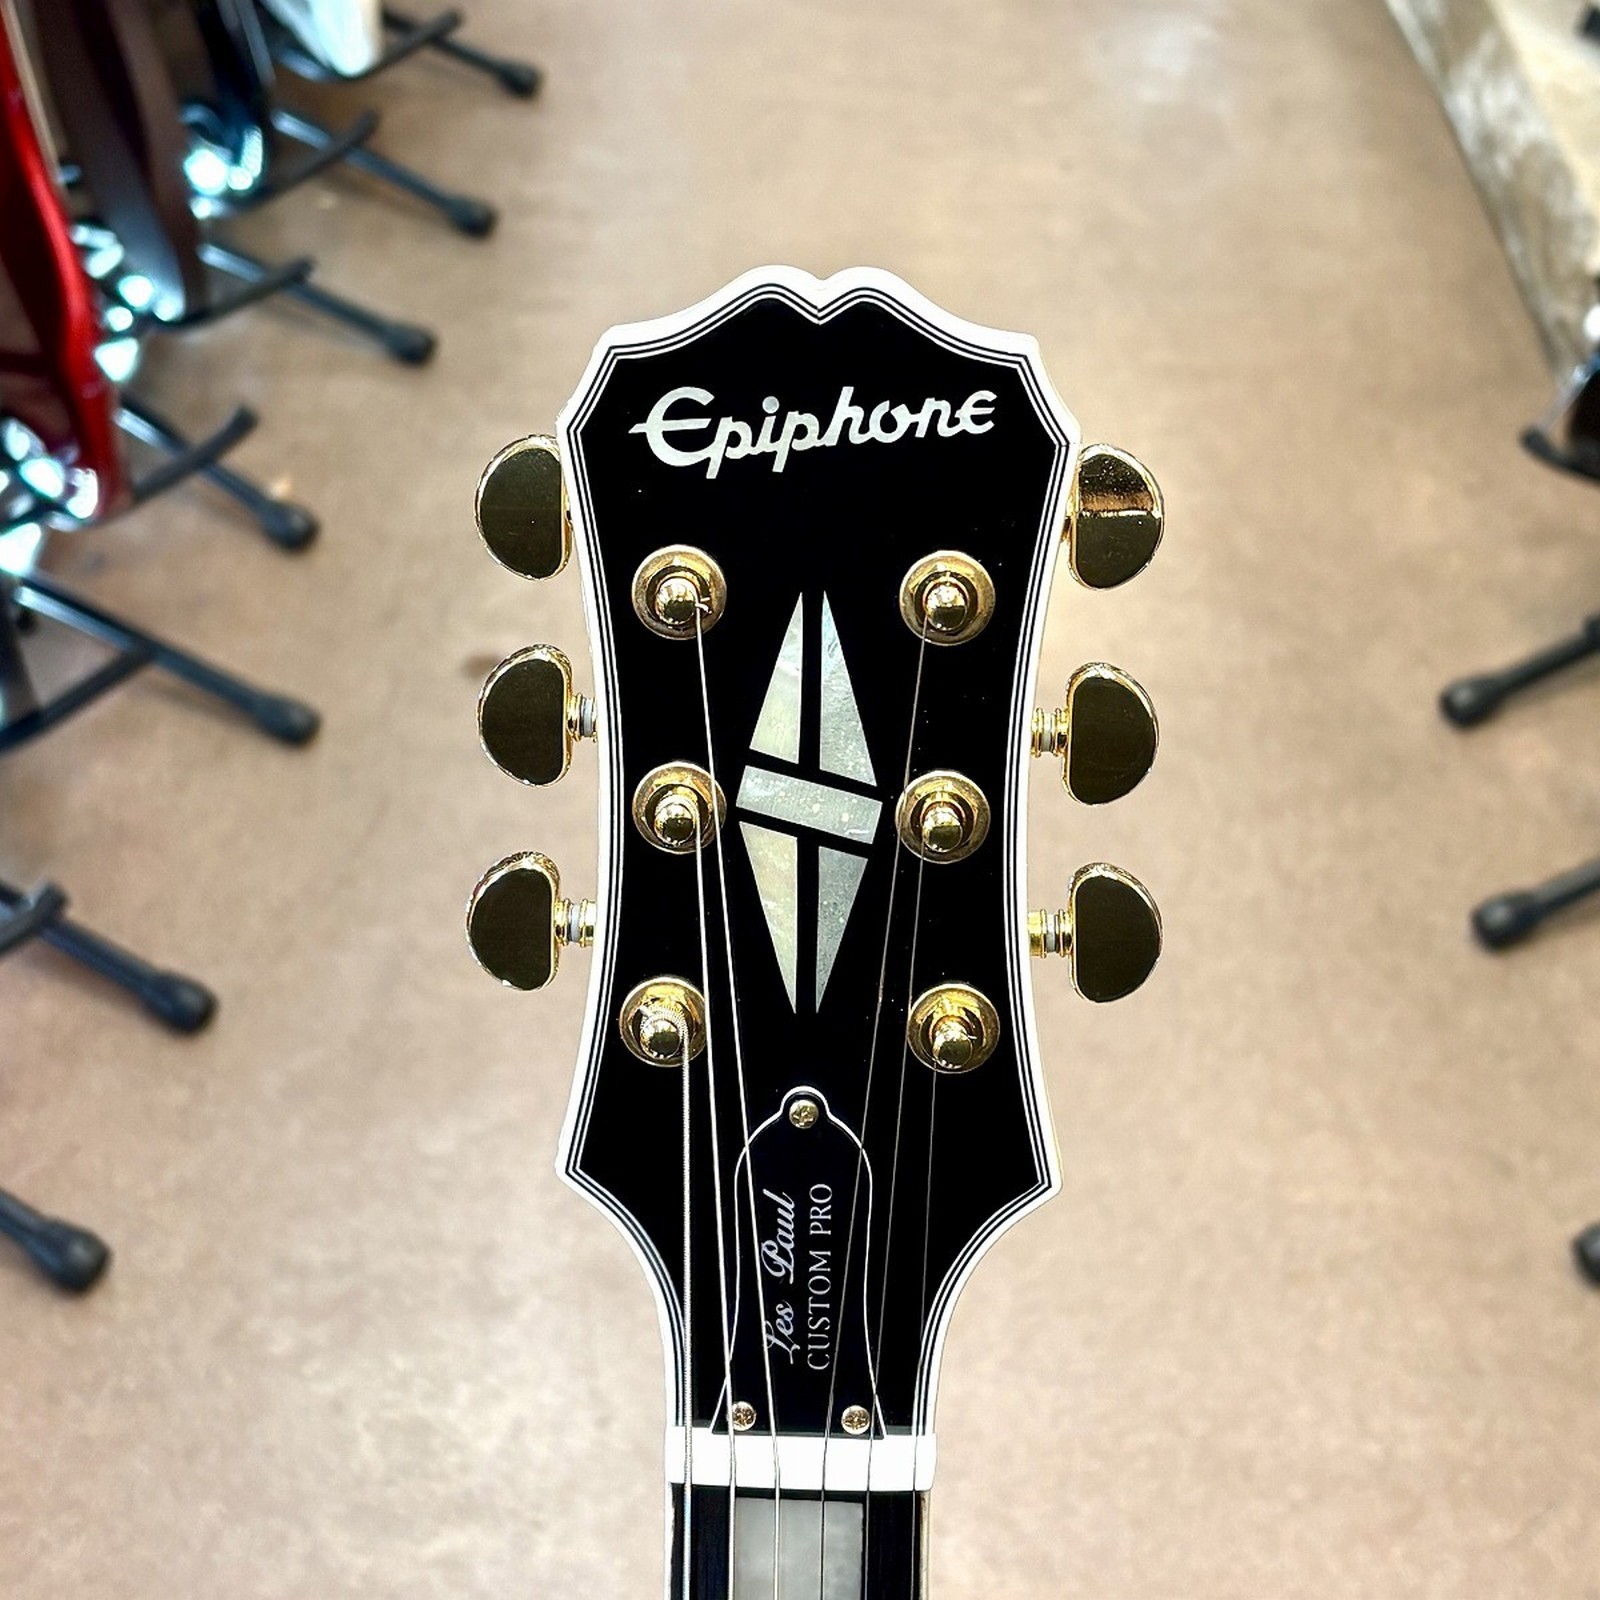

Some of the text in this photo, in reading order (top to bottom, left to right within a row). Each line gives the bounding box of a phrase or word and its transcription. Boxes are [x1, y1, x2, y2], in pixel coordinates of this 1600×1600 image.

[628, 386, 997, 479] Epiphone
[761, 1188, 800, 1364] Les Paul
[807, 1183, 833, 1370] CUSTOM PRO
